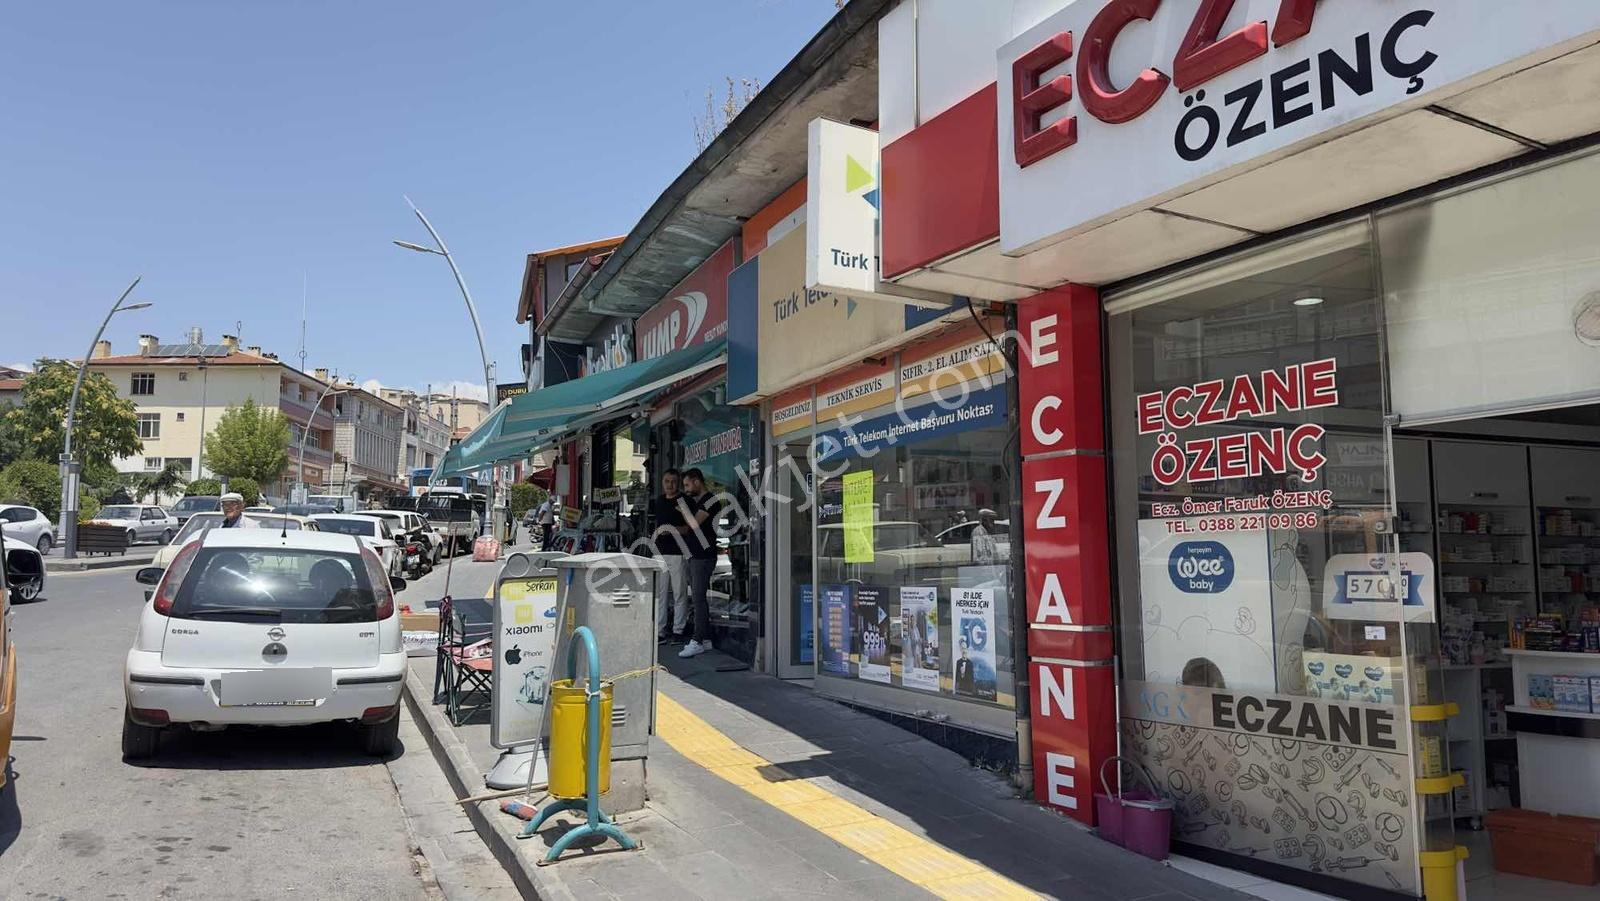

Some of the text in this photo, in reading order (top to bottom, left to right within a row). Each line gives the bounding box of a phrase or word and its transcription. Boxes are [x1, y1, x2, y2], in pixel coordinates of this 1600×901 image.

[1174, 10, 1438, 162] ÖZENÇ
[831, 248, 868, 270] Türk
[773, 291, 799, 323] Türk
[902, 364, 923, 381] SIFIR
[937, 356, 949, 370] EL
[949, 349, 973, 367] ALIM
[507, 387, 527, 396] DURU
[827, 378, 882, 407] TEKNİK SERVİS
[1137, 358, 1339, 434] ECZANE
[859, 428, 887, 444] Telekom
[888, 420, 919, 438] İnternet
[921, 412, 955, 432] Başvuru
[1151, 423, 1327, 485] ÖZENÇ
[1151, 489, 1333, 518] Ecz. Ömer Faruk ÖZENÇ
[1166, 512, 1318, 533] TEL. 0388 221 09 86
[1030, 313, 1078, 809] ECZANE
[526, 579, 555, 593] Serkan
[1189, 579, 1214, 591] baby
[955, 600, 977, 608] HERKES
[505, 624, 543, 636] xiaomi
[1212, 693, 1397, 750] ECZANE
